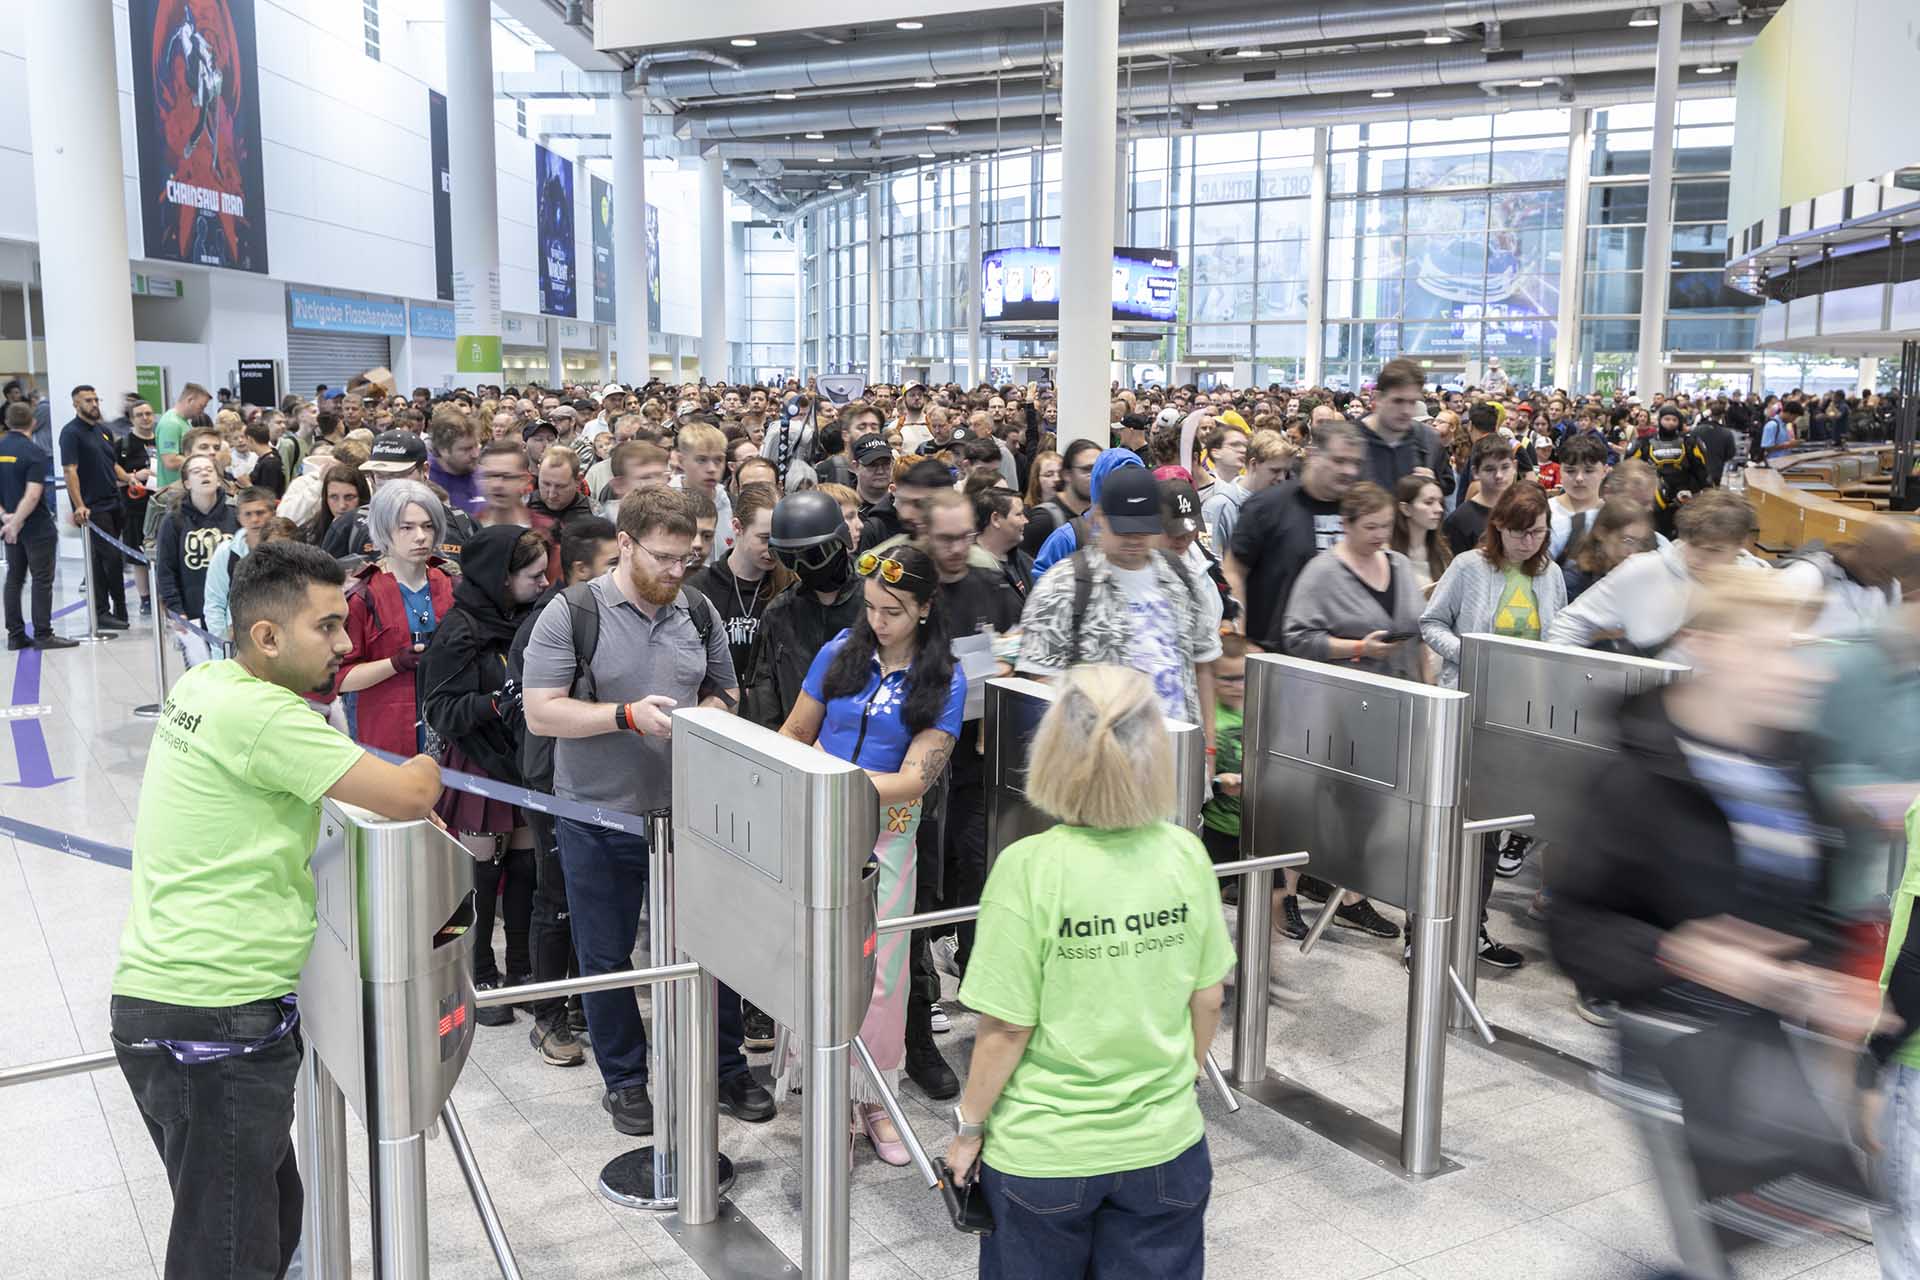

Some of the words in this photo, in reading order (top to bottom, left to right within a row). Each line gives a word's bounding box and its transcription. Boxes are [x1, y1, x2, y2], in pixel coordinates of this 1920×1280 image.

[166, 180, 219, 212] CHAINSAW
[221, 192, 244, 217] MAN
[1177, 494, 1192, 513] LA
[1125, 903, 1188, 935] quest
[1057, 944, 1102, 960] Assist
[1107, 940, 1129, 957] all
